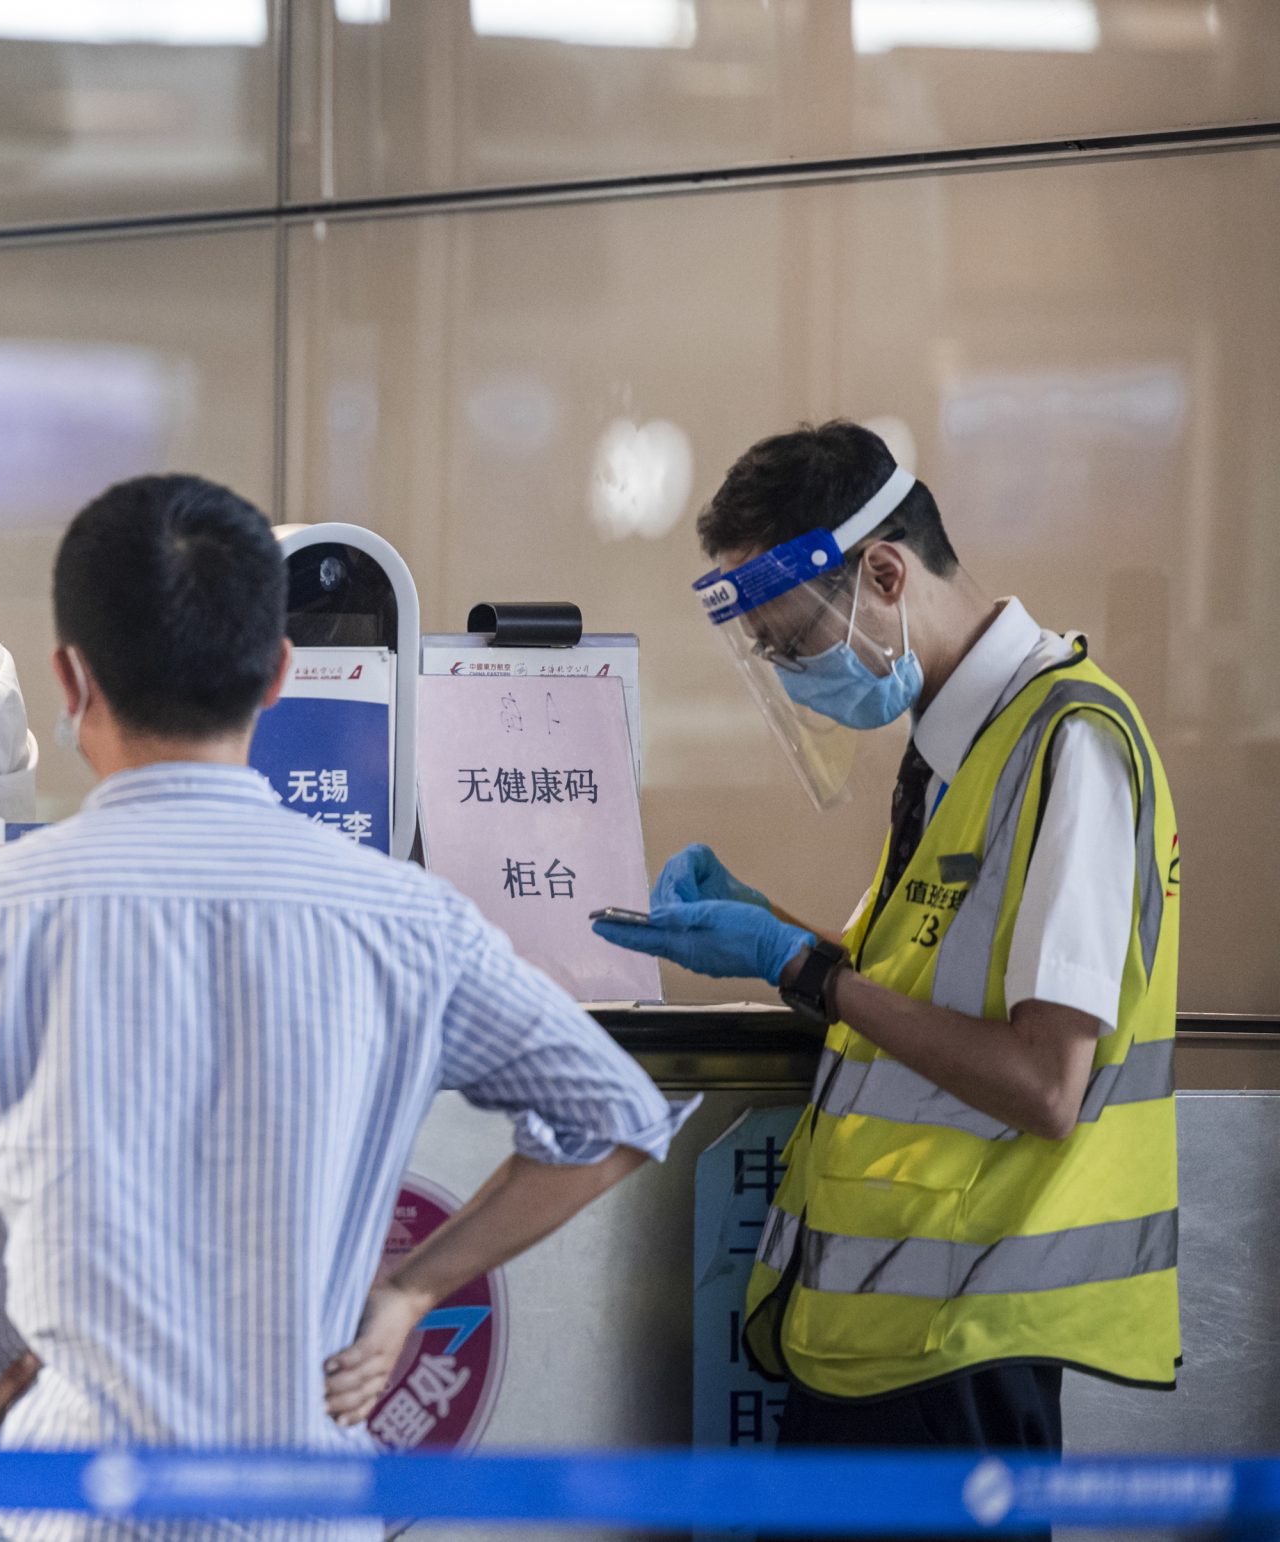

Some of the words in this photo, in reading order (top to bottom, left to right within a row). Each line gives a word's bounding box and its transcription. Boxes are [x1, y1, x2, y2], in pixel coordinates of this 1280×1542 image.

[702, 585, 730, 608] ield
[288, 769, 348, 803] 无锡
[458, 767, 598, 804] 无健康码
[502, 857, 576, 899] 柜台
[911, 913, 940, 948] 13
